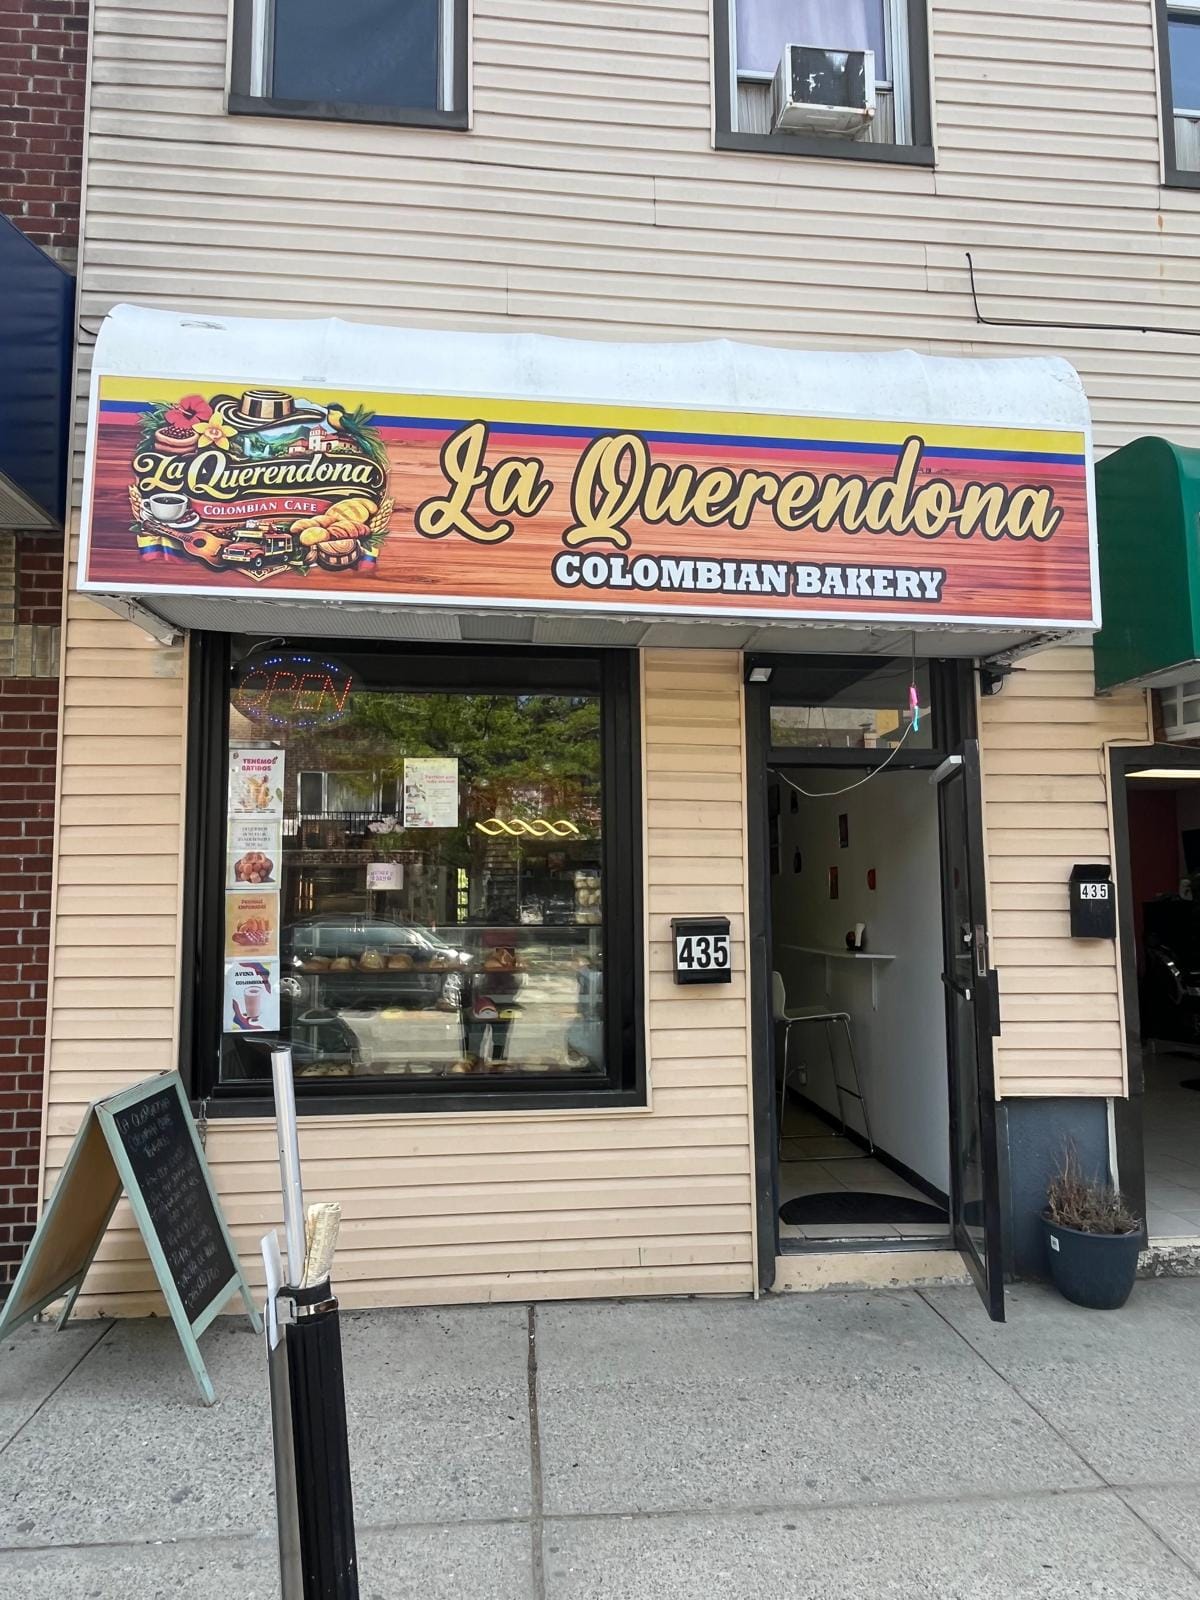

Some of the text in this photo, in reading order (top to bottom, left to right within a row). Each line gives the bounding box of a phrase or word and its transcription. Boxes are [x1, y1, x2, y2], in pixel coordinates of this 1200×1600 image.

[133, 451, 373, 499] La Querendona
[418, 421, 1060, 547] La Querendona
[203, 500, 319, 516] COLOMBIAN CAFE
[555, 554, 943, 599] COLOMBIAN BAKERY
[238, 669, 353, 712] OPEN
[1080, 883, 1109, 900] 435
[677, 935, 730, 971] 435
